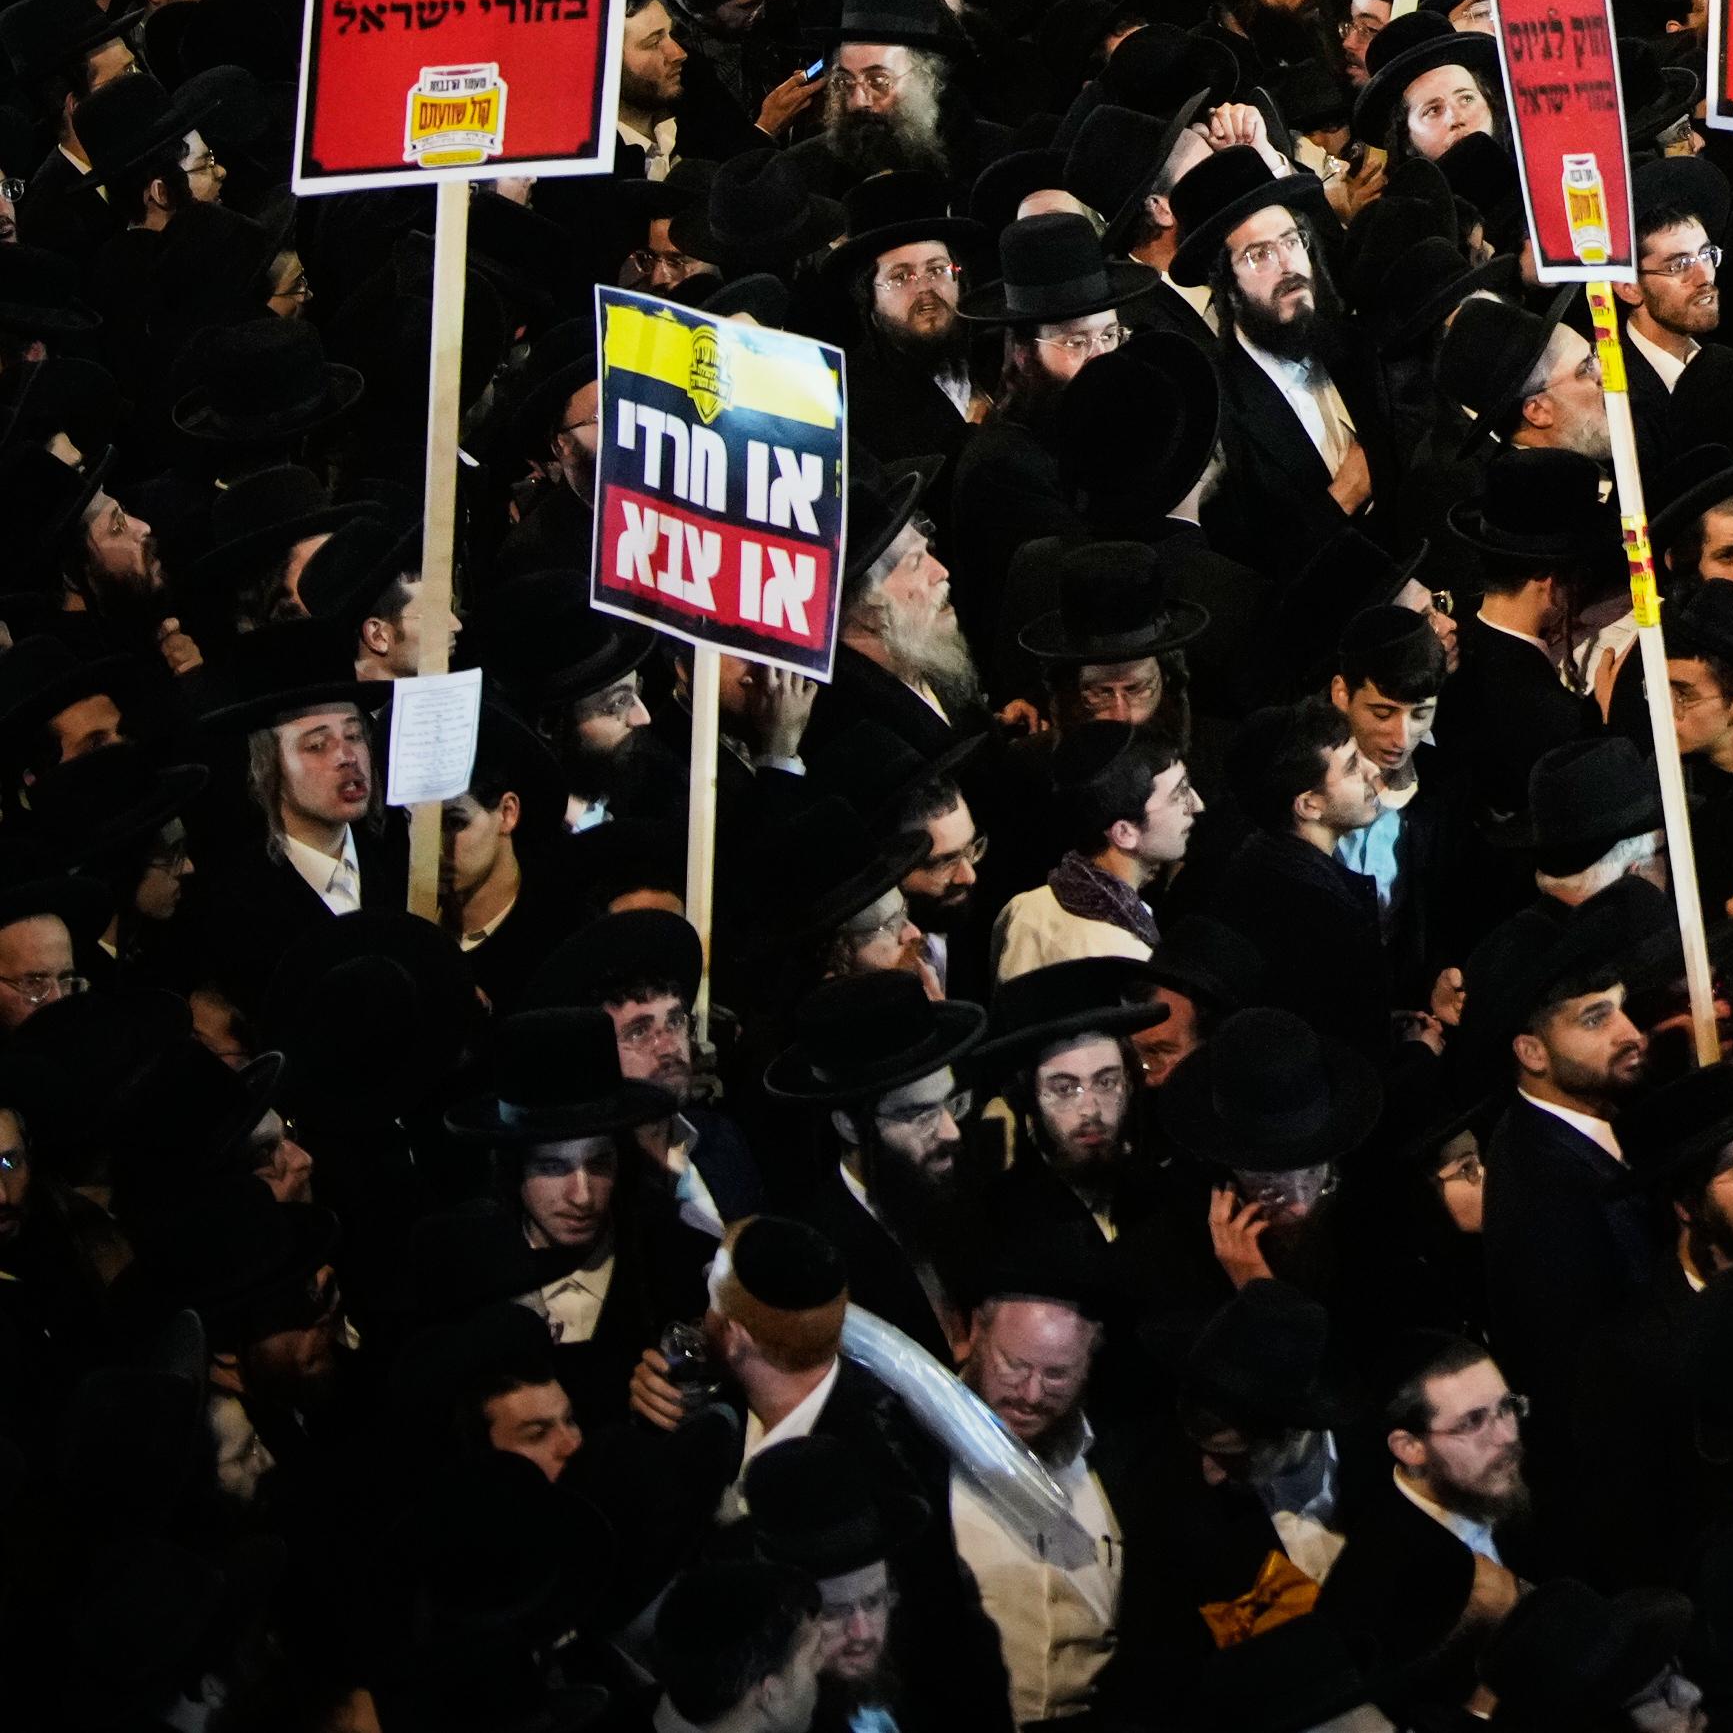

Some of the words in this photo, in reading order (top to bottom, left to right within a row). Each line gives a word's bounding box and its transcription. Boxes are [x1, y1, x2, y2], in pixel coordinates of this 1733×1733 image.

[1508, 8, 1564, 62] לגיוס
[470, 97, 491, 128] קול
[1516, 80, 1569, 115] ישראל
[617, 398, 728, 513] חרדי
[746, 439, 824, 536] או
[616, 500, 722, 612] צבא
[739, 540, 816, 635] או
